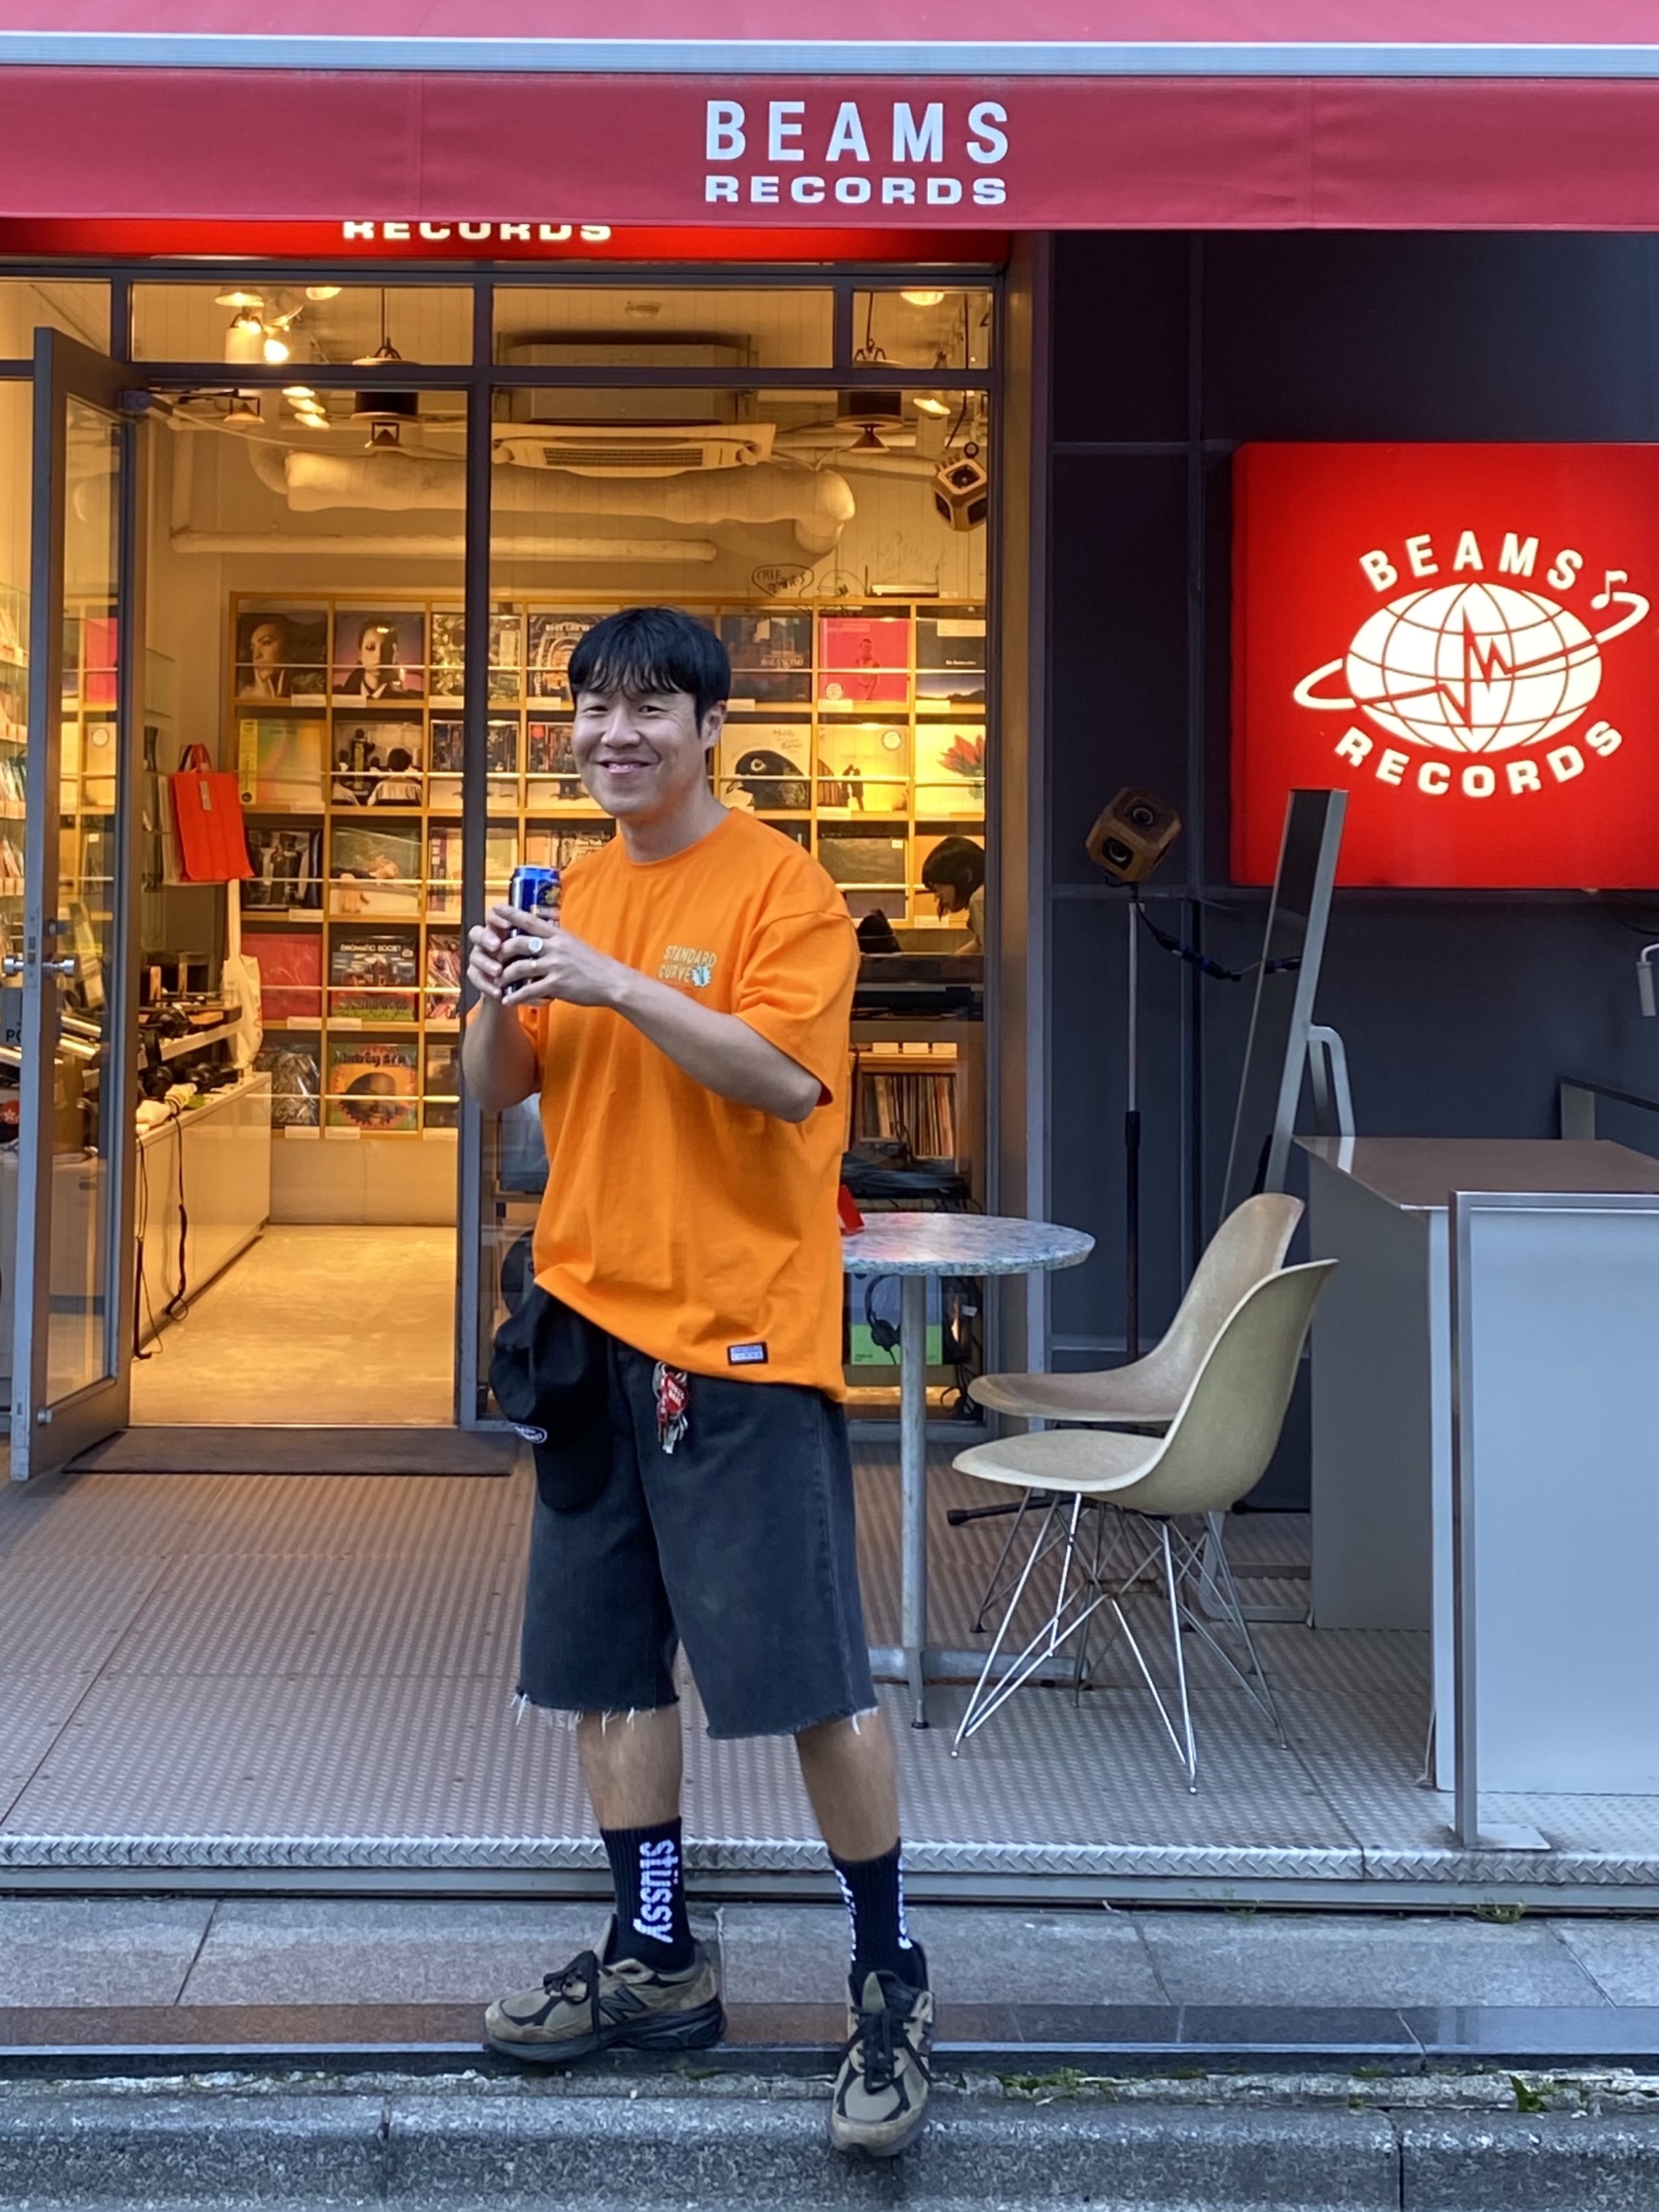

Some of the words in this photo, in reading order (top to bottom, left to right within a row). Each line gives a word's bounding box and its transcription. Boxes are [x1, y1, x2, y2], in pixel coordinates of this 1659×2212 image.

[706, 100, 1009, 164] BEAMS
[705, 175, 1006, 205] RECORDS
[1358, 530, 1583, 593] BEAMS
[1334, 720, 1623, 798] RECORDS
[663, 945, 717, 969] STANDARD
